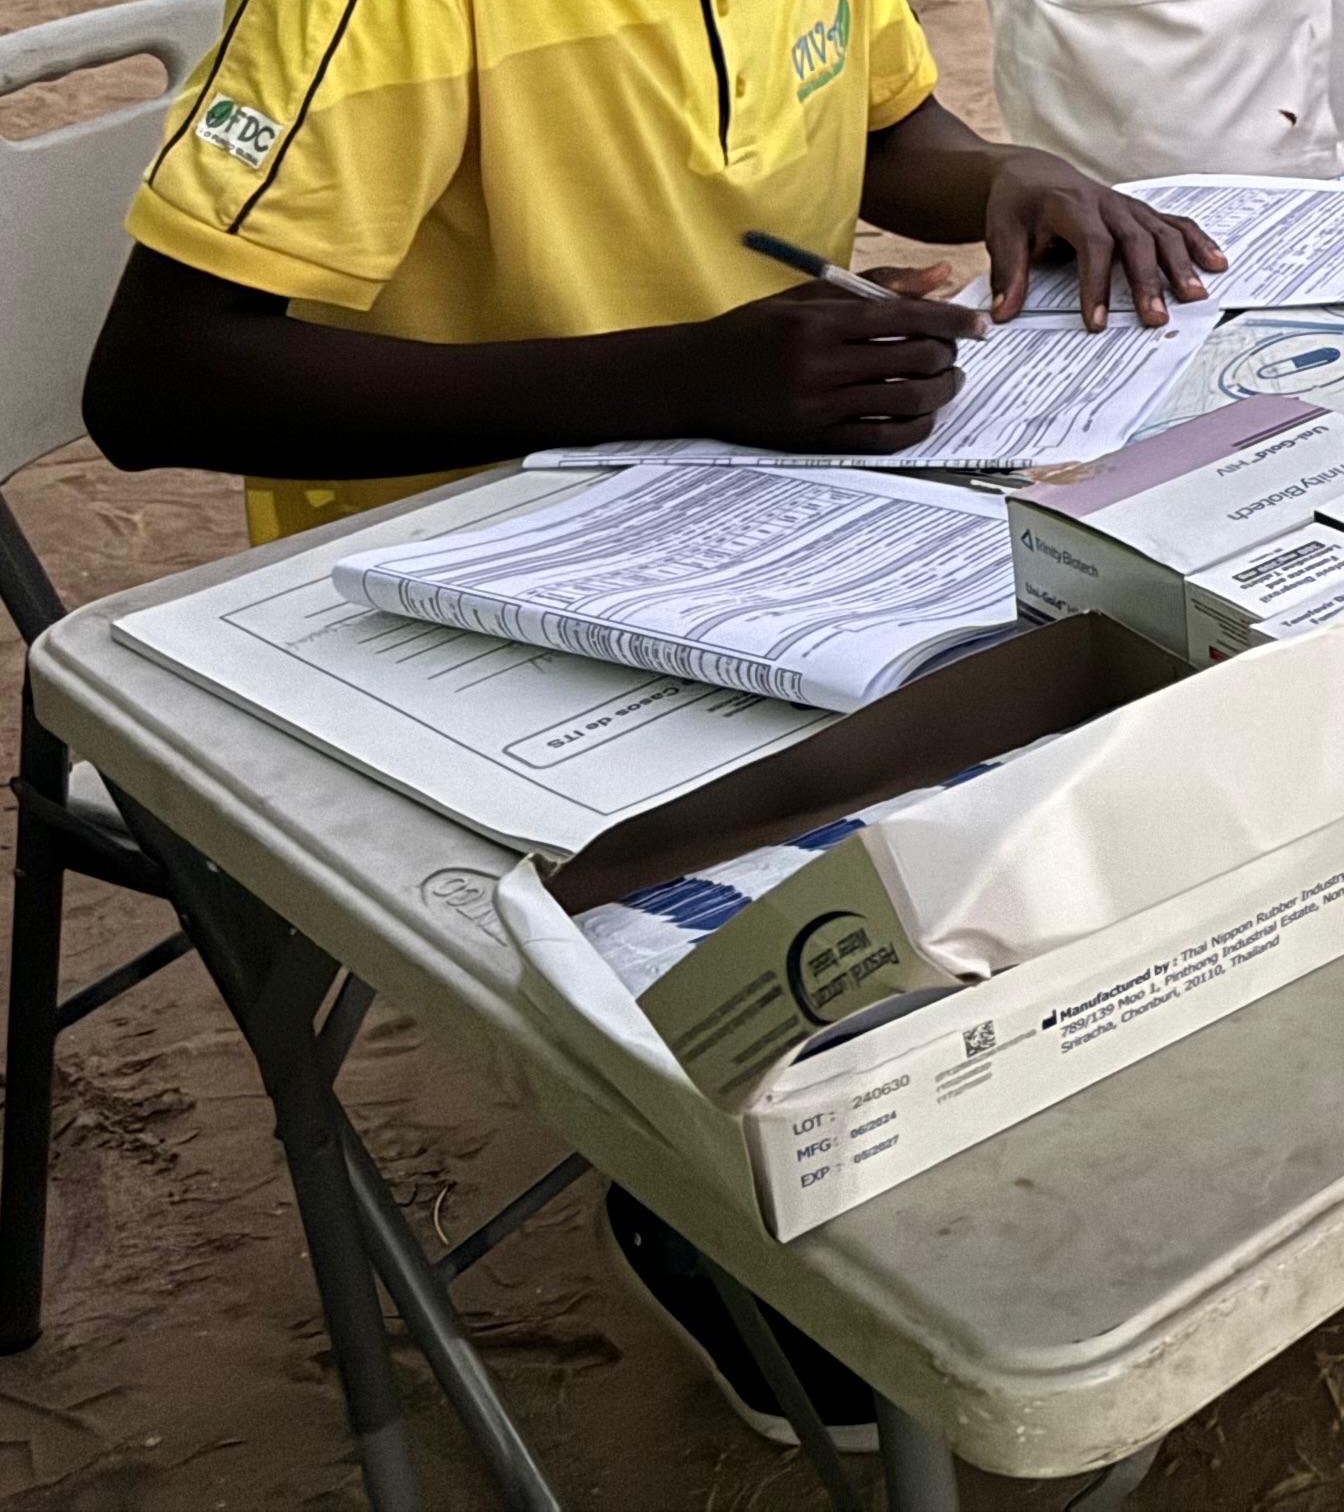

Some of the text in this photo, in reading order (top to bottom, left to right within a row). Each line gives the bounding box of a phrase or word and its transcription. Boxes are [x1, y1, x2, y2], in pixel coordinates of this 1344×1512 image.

[224, 108, 276, 153] FDC
[1216, 459, 1248, 478] HIV
[546, 685, 680, 750] Casos de ITS
[1060, 966, 1152, 1023] Manufactured
[1154, 958, 1170, 979] by
[1181, 940, 1208, 963] Thai
[1211, 919, 1253, 951] Nippon
[1256, 895, 1298, 925] Rubber
[1061, 1004, 1116, 1038] 789/139
[1117, 989, 1146, 1009] Moo
[1164, 952, 1220, 987] Pinthong
[1222, 923, 1278, 958] Industrial
[1281, 902, 1320, 929] Estate,
[1060, 934, 1281, 1054] Sriracha, Chonburi, 20110, Thailand
[792, 1074, 911, 1137] LOT 240630
[796, 1138, 832, 1163] MFG
[800, 1165, 831, 1189] EXP
